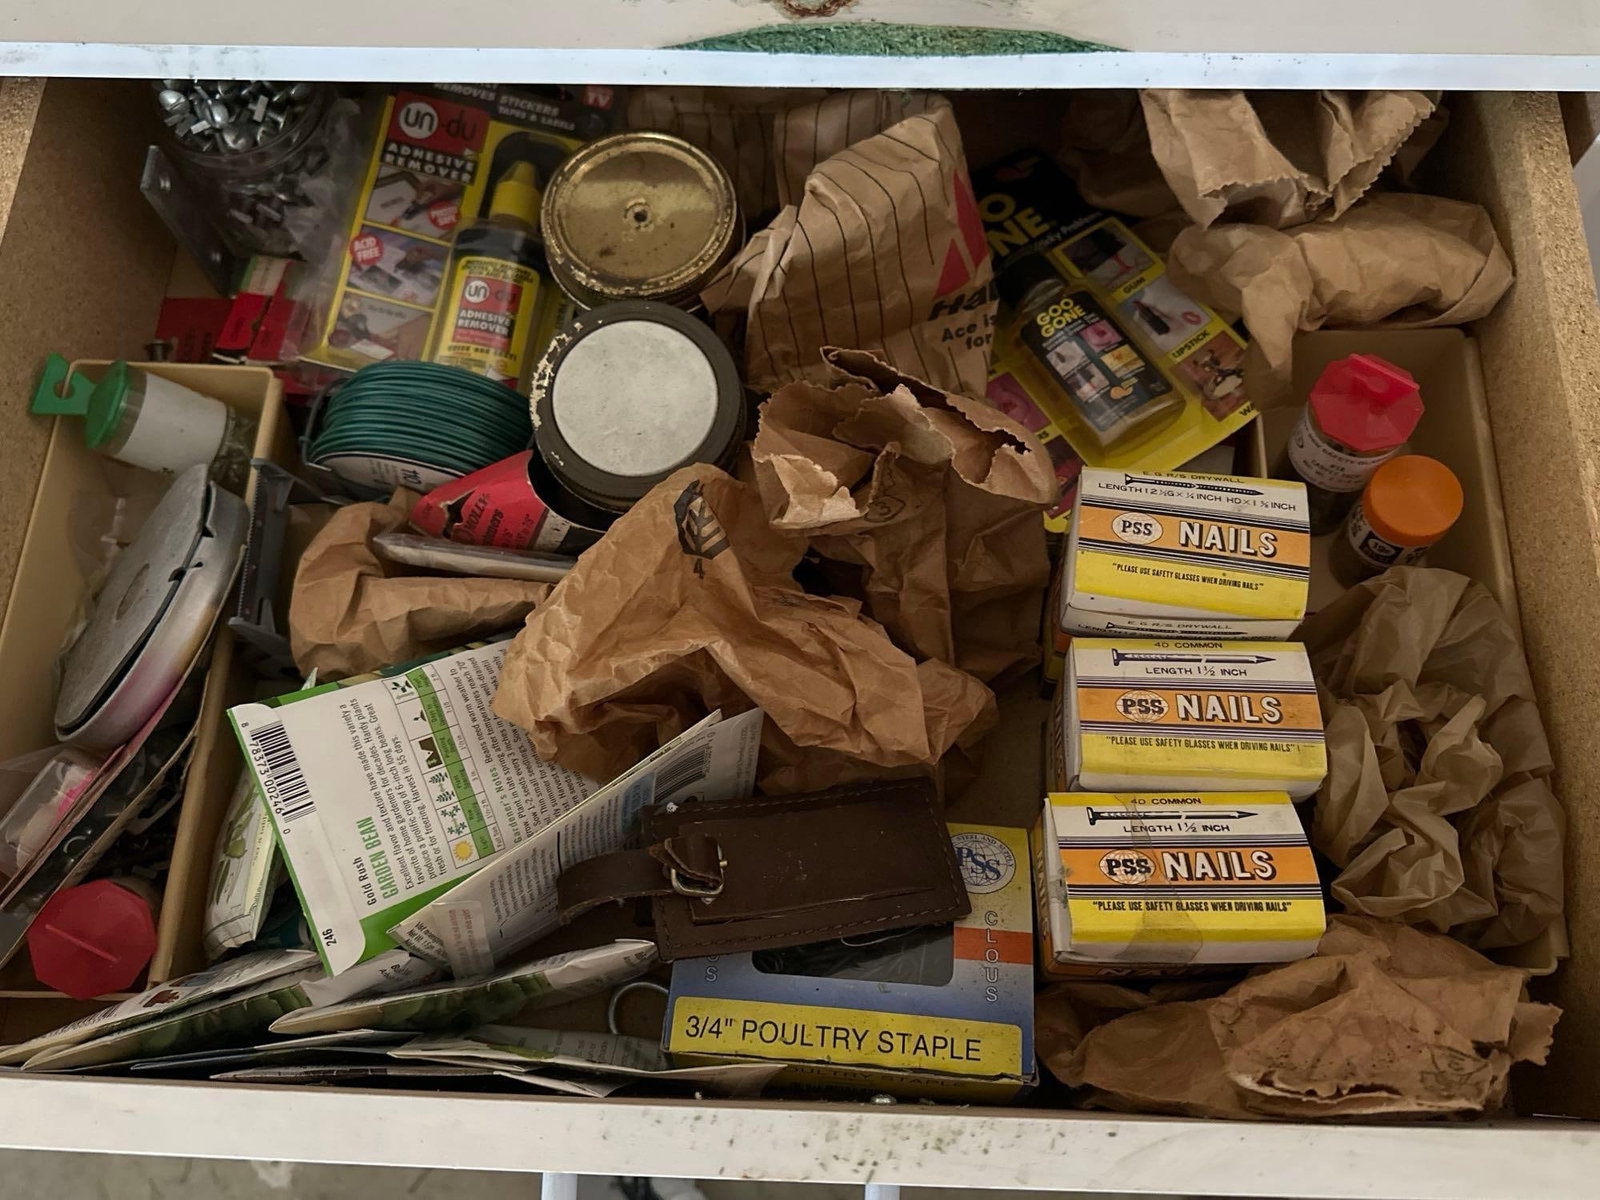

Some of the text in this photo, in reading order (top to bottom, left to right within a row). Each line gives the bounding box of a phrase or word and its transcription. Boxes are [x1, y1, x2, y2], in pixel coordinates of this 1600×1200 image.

[387, 142, 475, 171] ADHESIVE
[384, 153, 472, 184] REMOVER
[1123, 276, 1146, 294] GUM
[460, 309, 512, 328] ADHESIVE
[1036, 298, 1074, 326] GOO
[1041, 305, 1086, 338] GONE
[457, 319, 510, 335] REMOVER
[942, 323, 978, 342] Ace
[965, 333, 992, 350] for
[1171, 329, 1212, 359] LIPSTICK
[1190, 474, 1245, 484] DRYWALL
[1098, 482, 1296, 512] LENGTH INCH HD INCH
[1121, 519, 1153, 538] PSS
[1178, 521, 1279, 558] NAILS
[1139, 566, 1151, 576] USE
[1151, 568, 1174, 579] SAFETY
[1174, 572, 1200, 583] GLASSES
[1201, 575, 1218, 585] WHEN
[1218, 577, 1242, 589] DRIVING
[455, 658, 467, 671] 70°
[481, 658, 494, 675] until
[1145, 667, 1247, 677] LENGTH INCH
[462, 669, 476, 690] reach
[467, 655, 491, 698] well-drained
[363, 702, 378, 724] Great
[471, 689, 495, 735] temperatures
[1122, 698, 1165, 715] PSS
[1176, 694, 1284, 724] NAILS
[340, 708, 358, 735] variety
[495, 720, 503, 728] in
[349, 734, 363, 750] this
[372, 723, 388, 749] beans.
[488, 734, 501, 753] after
[497, 728, 513, 752] inches
[509, 727, 521, 743] Sow
[1140, 737, 1153, 746] USE
[1155, 738, 1182, 748] SAFETY
[1184, 739, 1216, 749] GLASSES
[1217, 740, 1239, 750] WHEN
[1240, 741, 1268, 751] DRIVING
[355, 749, 371, 772] made
[381, 747, 395, 765] long
[448, 667, 523, 843] Gardener's Notes Beans need warm weather to
[496, 751, 512, 775] spring
[516, 743, 535, 778] seedlings.
[510, 756, 523, 776] every
[364, 771, 378, 791] have
[387, 765, 404, 790] 6-inch
[504, 775, 516, 790] late
[516, 776, 530, 797] seeds
[528, 777, 542, 798] small
[537, 768, 558, 807] summer for
[550, 772, 566, 799] Harvest
[249, 741, 270, 775] 78373
[264, 780, 287, 815] 00246
[283, 828, 291, 836] 0
[348, 697, 426, 885] favorite of home gardeners for decades. Hardy plants
[396, 790, 407, 799] of
[509, 790, 518, 799] in
[371, 790, 388, 817] texture
[389, 734, 448, 875] fresh or for freezing. Harvest in 55 days.
[401, 798, 415, 816] crop
[512, 799, 526, 818] Plant
[524, 797, 535, 810] 1-2
[536, 797, 548, 814] Thin
[1151, 797, 1202, 805] COMMON
[381, 817, 394, 833] and
[521, 818, 534, 837] grow.
[529, 810, 541, 826] Sow
[1123, 824, 1230, 833] LENGTH INCH
[406, 815, 424, 843] prolific
[386, 832, 402, 855] flavor
[355, 815, 400, 899] GARDEN BEAN
[419, 849, 437, 879] produce
[956, 847, 1001, 880] PSS
[1106, 858, 1152, 876] PSS
[1162, 850, 1277, 881] NAILS
[351, 855, 378, 906] Gold Rush
[394, 855, 415, 890] Excellent
[1128, 901, 1143, 911] USE
[1145, 901, 1174, 911] SAFETY
[1175, 901, 1209, 911] GLASSES
[1210, 902, 1233, 911] WHEN
[1234, 902, 1264, 911] DRIVING
[321, 927, 337, 946] 246
[984, 910, 1000, 1003] CLOUS
[686, 1015, 982, 1062] 3/4" POULTRY STAPLE
